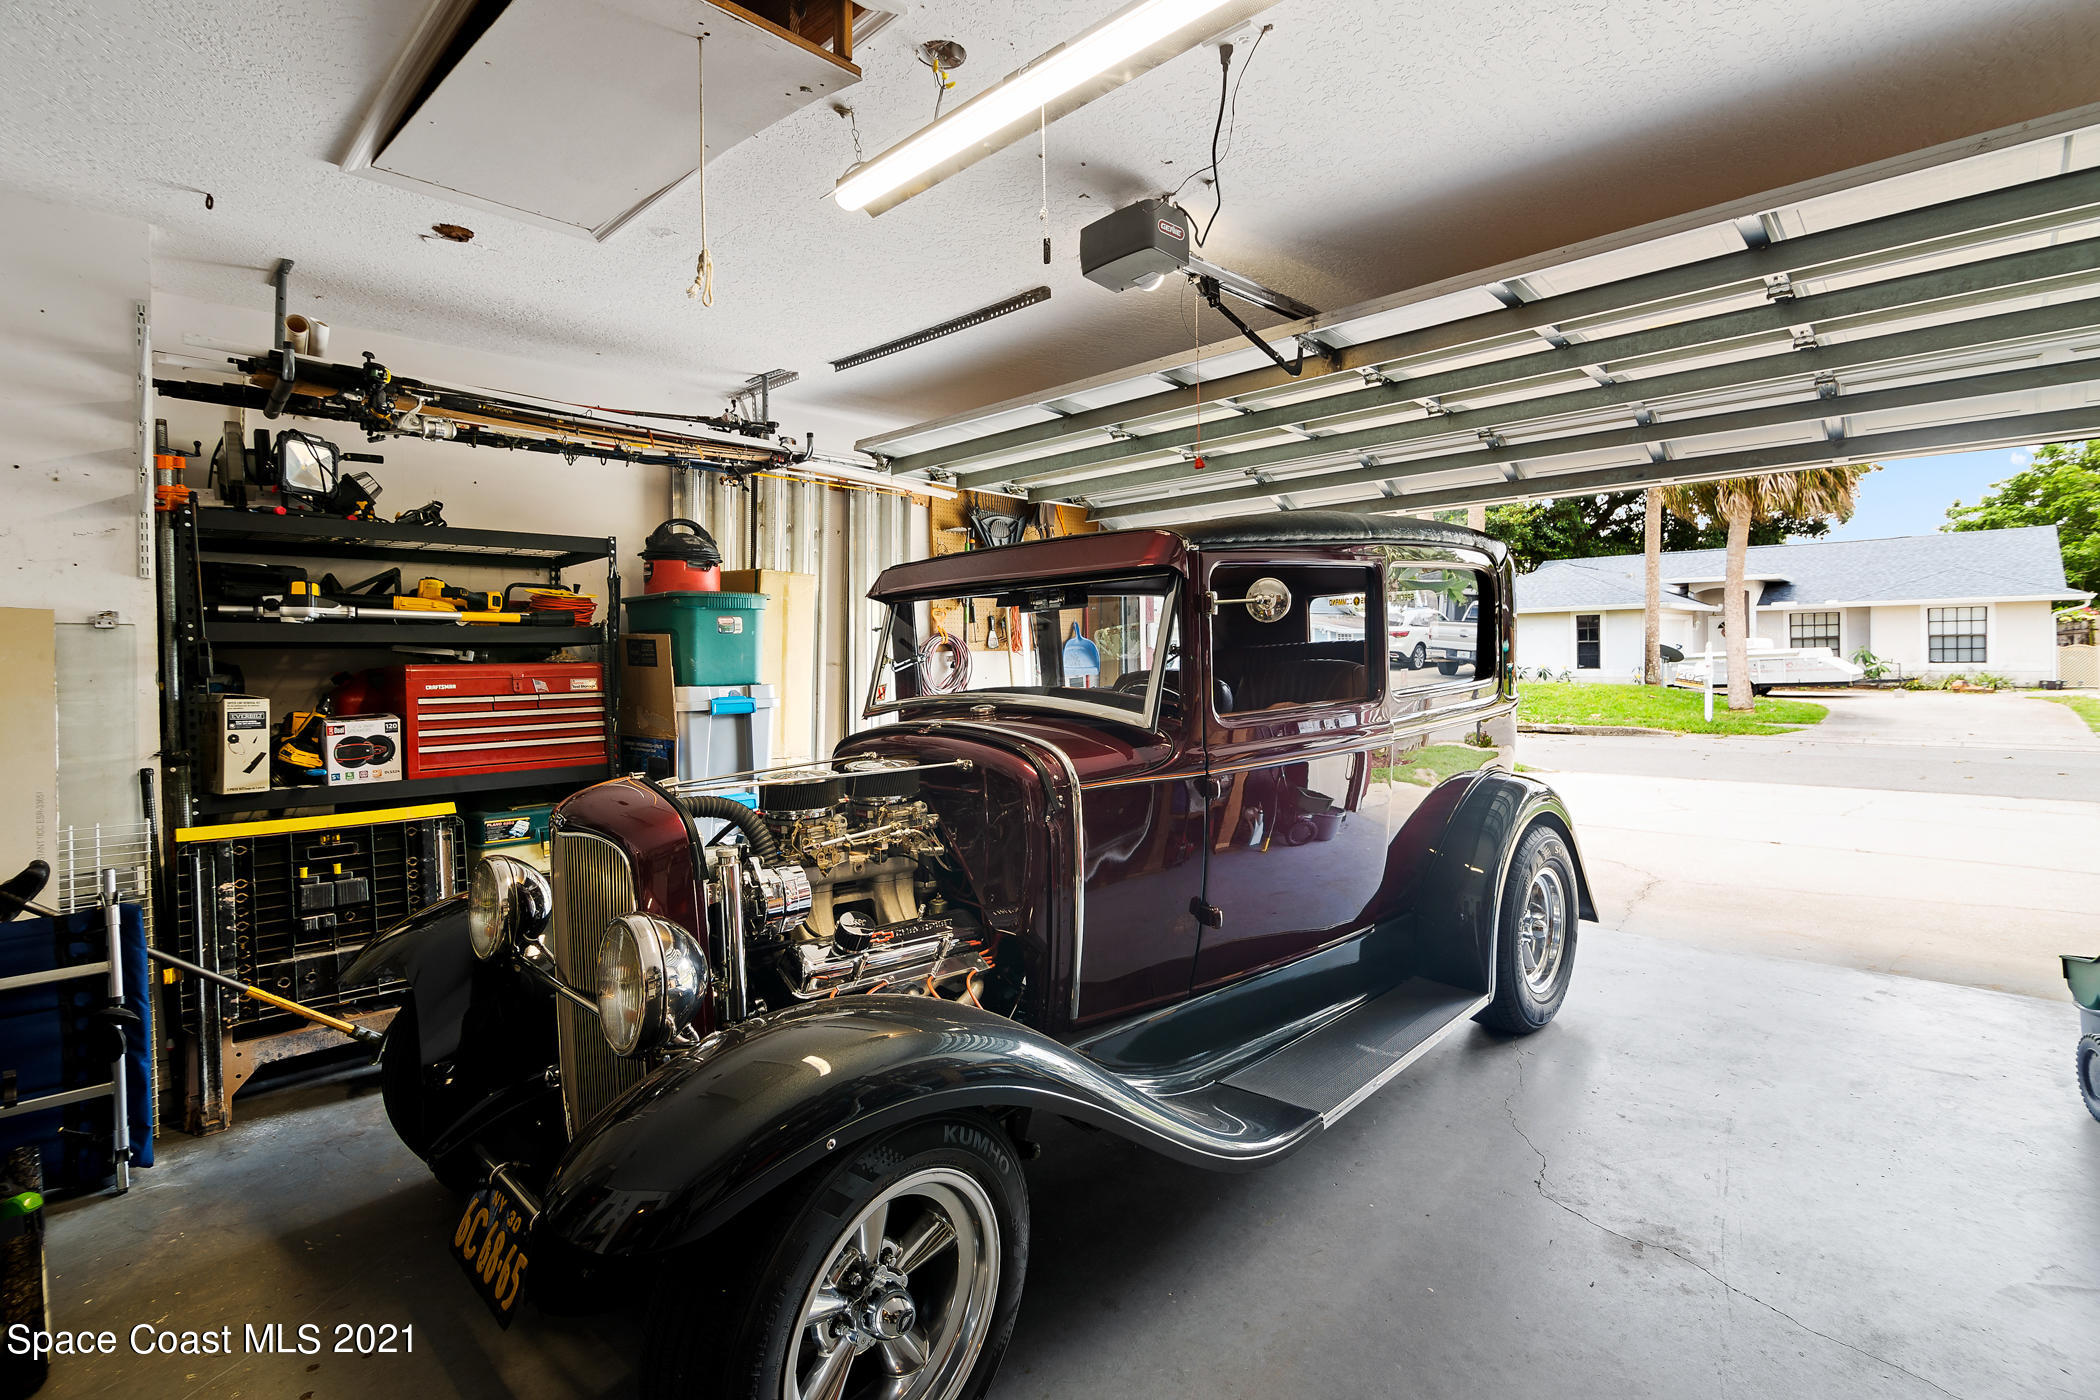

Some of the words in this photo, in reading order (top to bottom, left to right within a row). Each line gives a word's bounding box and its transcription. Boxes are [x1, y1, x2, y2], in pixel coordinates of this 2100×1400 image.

[230, 713, 264, 721] EVERBILT
[943, 1124, 1009, 1175] KUMHO
[507, 1210, 522, 1233] 30
